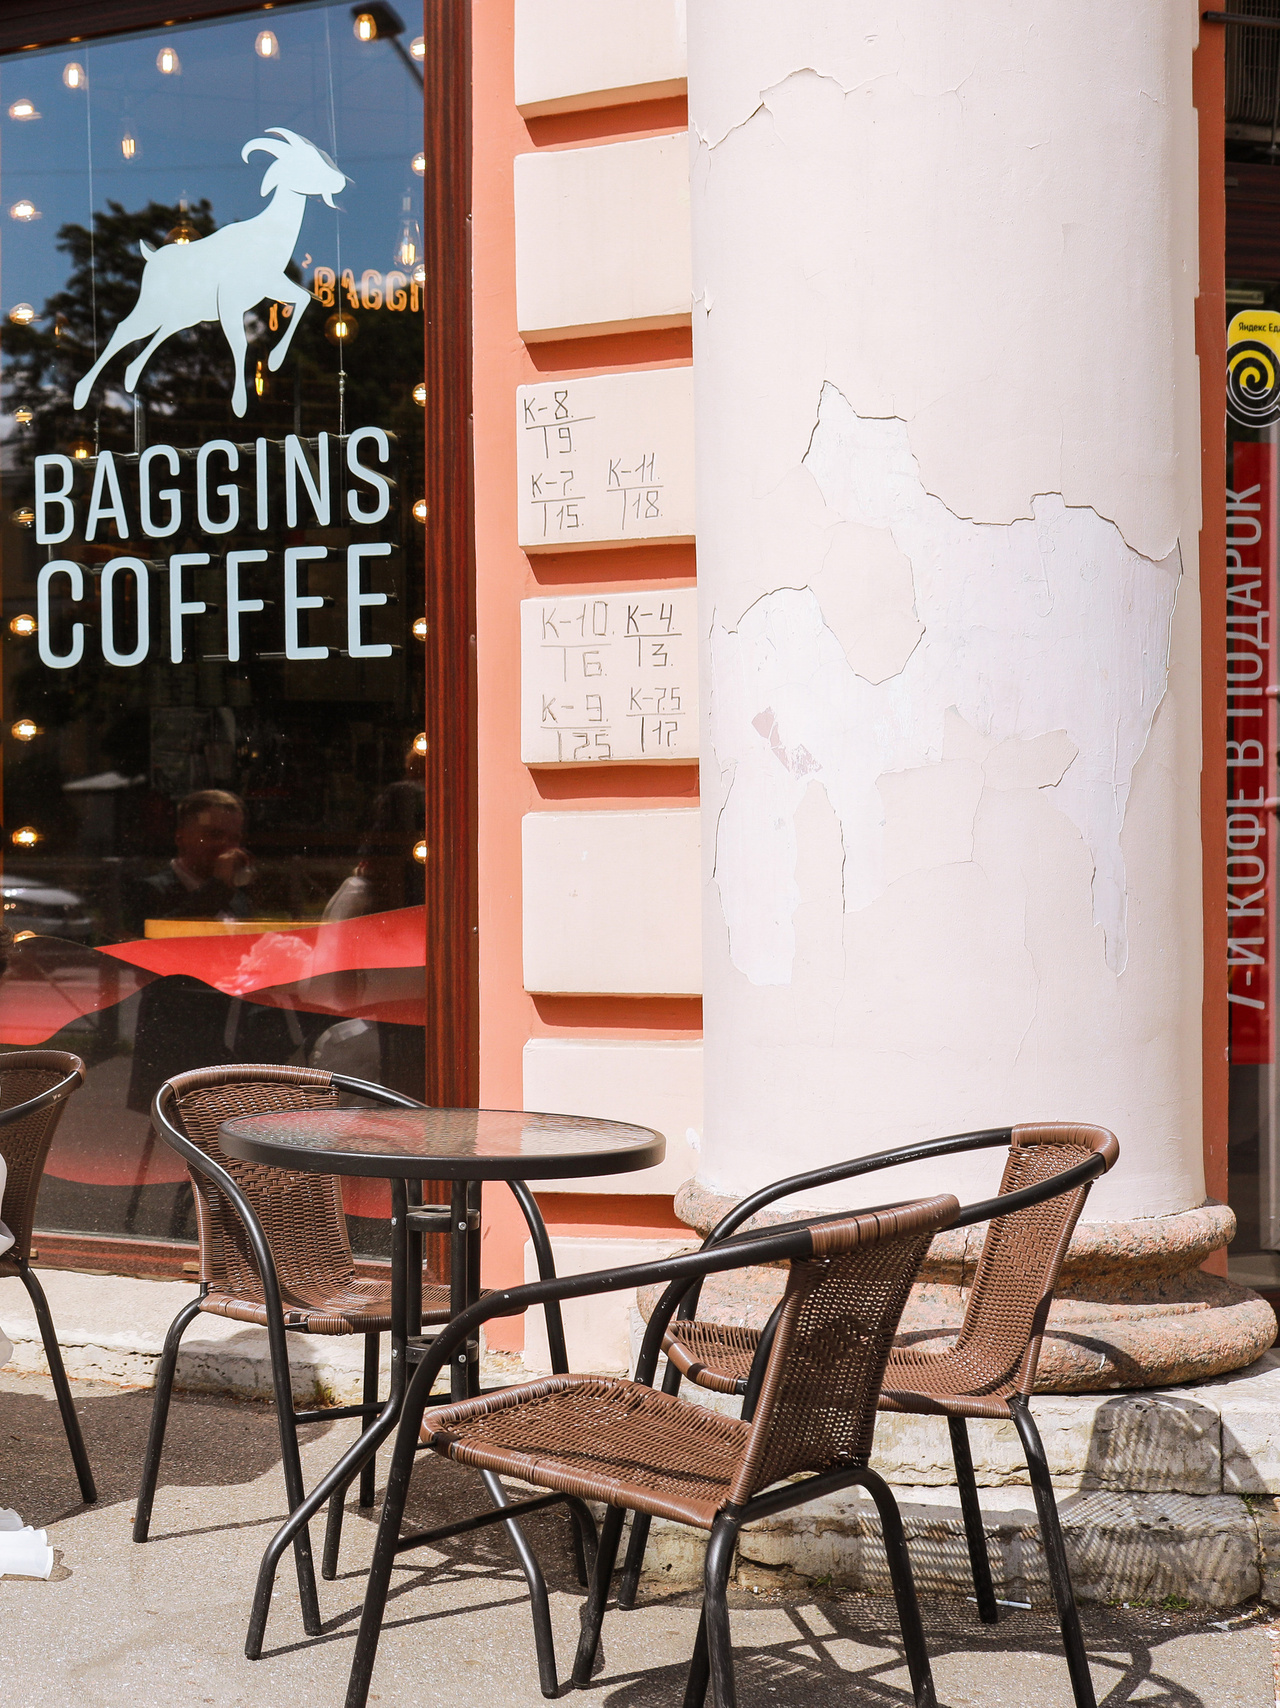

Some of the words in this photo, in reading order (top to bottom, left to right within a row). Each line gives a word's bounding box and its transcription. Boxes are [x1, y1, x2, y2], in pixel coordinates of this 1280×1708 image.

[314, 266, 425, 313] BAGGI
[1238, 321, 1266, 333] Яндекс
[1269, 322, 1280, 333] Ед
[33, 426, 391, 545] BAGGINS
[36, 543, 393, 669] COFFEE
[1226, 483, 1271, 717] ПОДАРОК
[1226, 738, 1265, 767] В
[1226, 786, 1267, 917] КОФЕ
